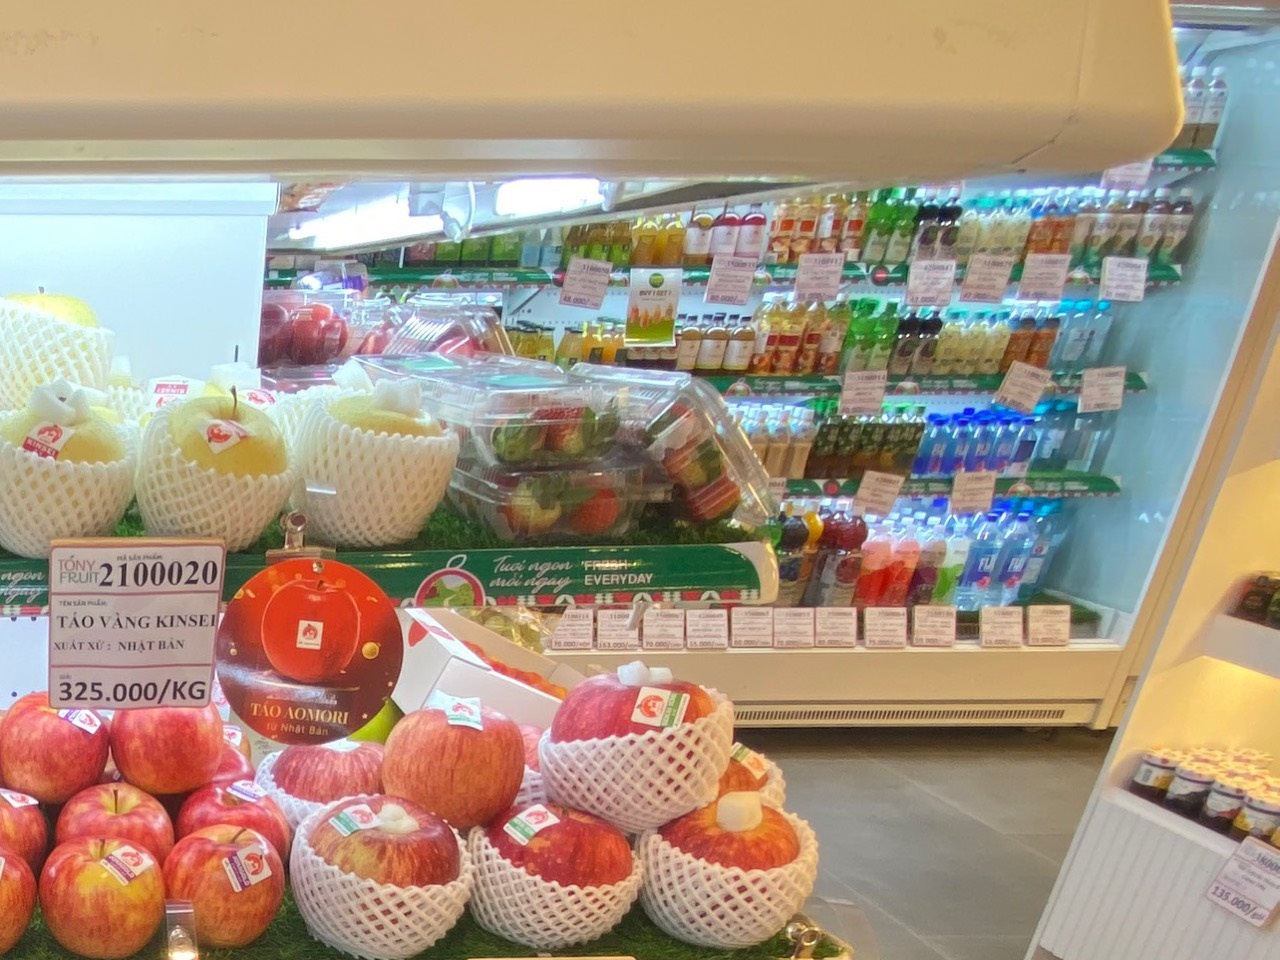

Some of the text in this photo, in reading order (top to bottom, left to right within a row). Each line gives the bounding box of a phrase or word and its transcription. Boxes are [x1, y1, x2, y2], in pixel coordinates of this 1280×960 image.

[59, 572, 101, 584] FRUIT
[99, 560, 218, 587] 2100020
[584, 574, 653, 584] EVERYDAY
[56, 612, 216, 629] TÁO VÀNG KINSEI
[59, 679, 206, 704] 325.000/KG
[284, 706, 350, 725] AOMORI
